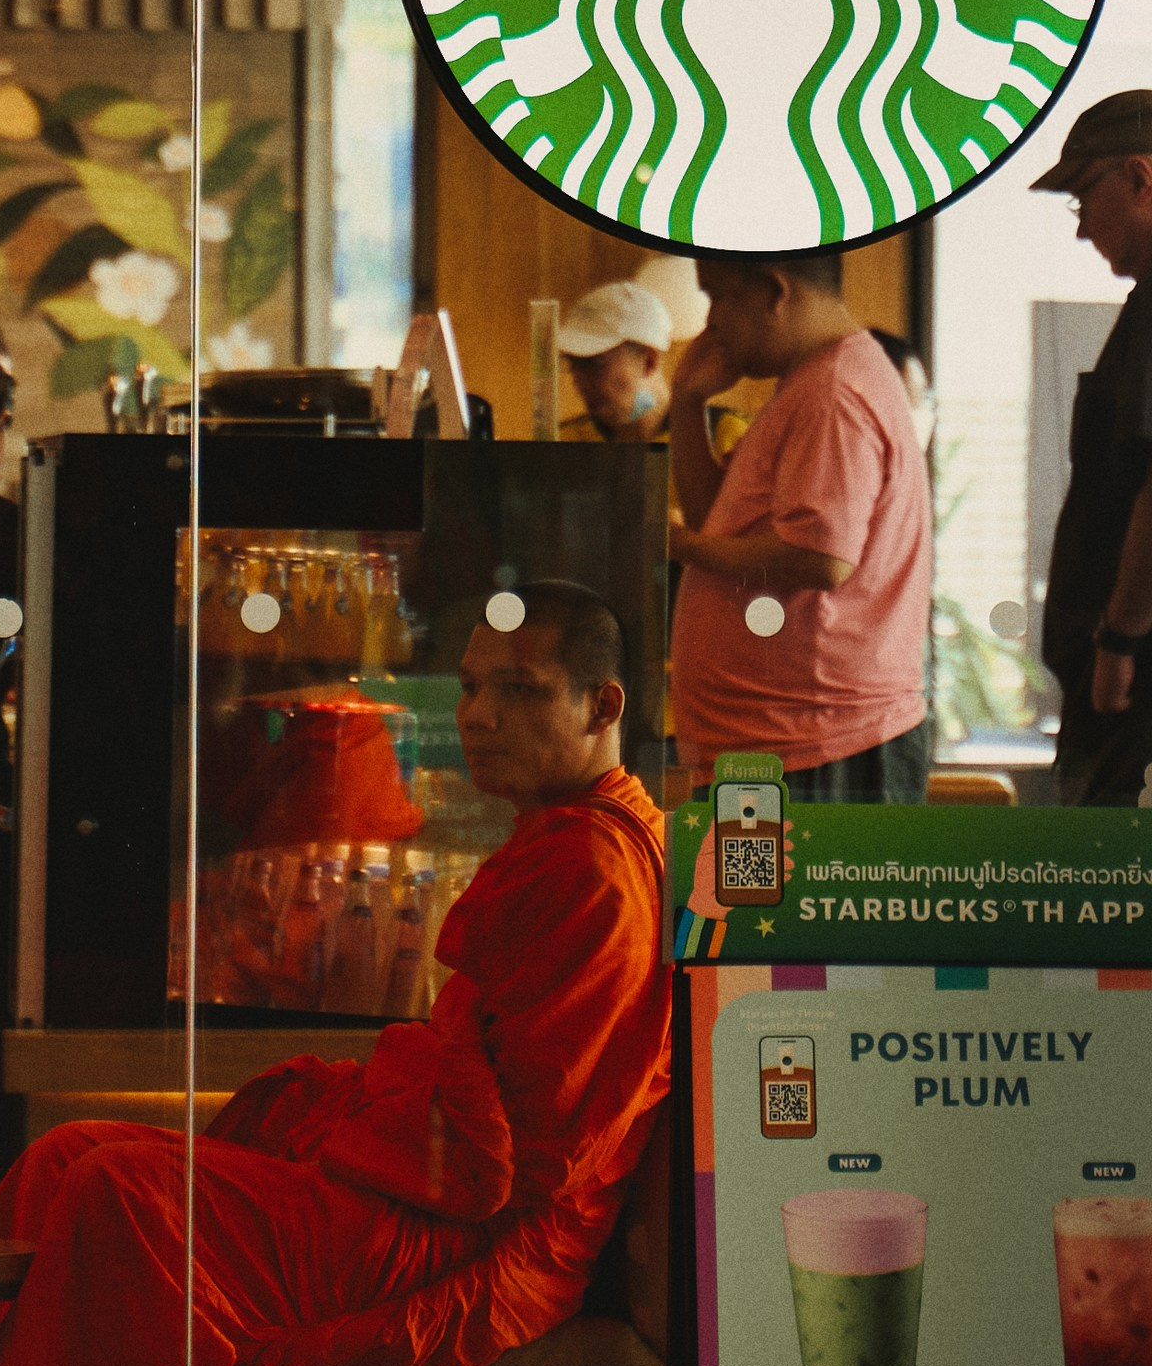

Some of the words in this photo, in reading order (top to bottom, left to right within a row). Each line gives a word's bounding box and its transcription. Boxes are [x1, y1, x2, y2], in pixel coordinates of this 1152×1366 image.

[1022, 899, 1064, 923] TH
[1077, 901, 1145, 924] APP
[850, 1031, 1093, 1062] POSITIVELY
[914, 1076, 1031, 1107] PLUM
[839, 1158, 870, 1169] NEW
[1093, 1167, 1125, 1177] NEW
